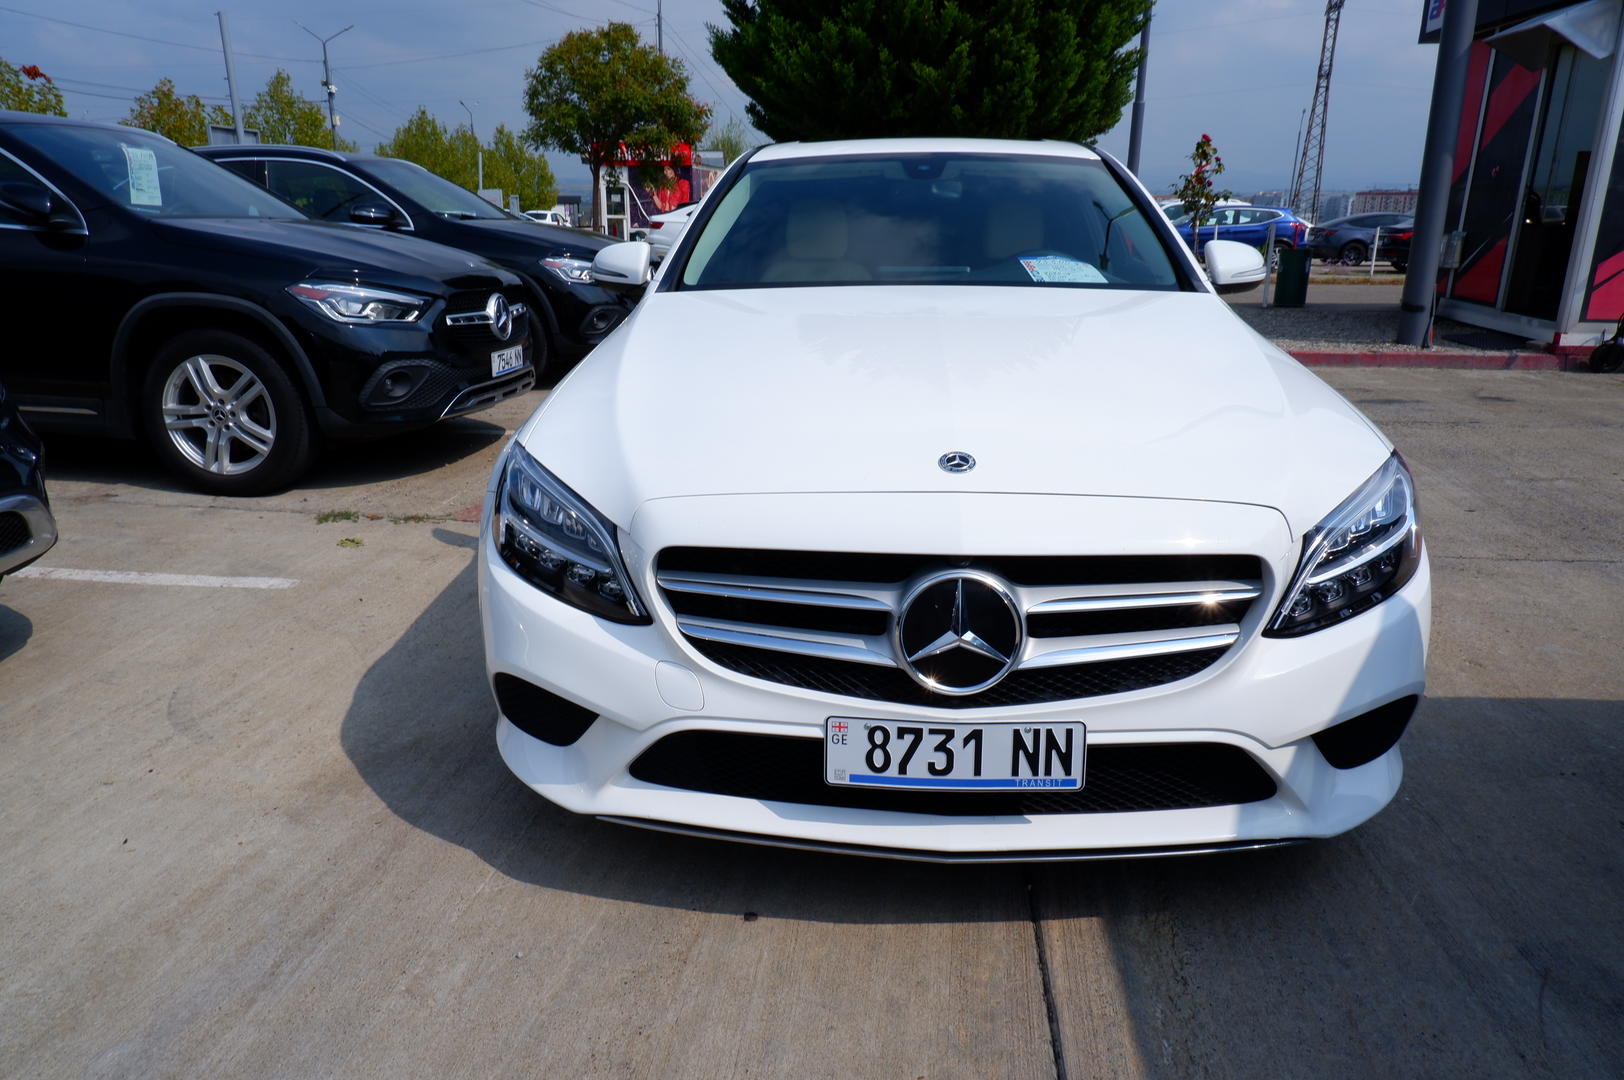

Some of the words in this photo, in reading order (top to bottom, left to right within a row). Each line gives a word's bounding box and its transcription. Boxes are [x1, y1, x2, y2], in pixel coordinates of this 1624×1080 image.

[831, 733, 848, 745] GE
[865, 725, 983, 777] 8731
[1011, 728, 1074, 777] NN
[1014, 779, 1063, 788] TRANSIT
